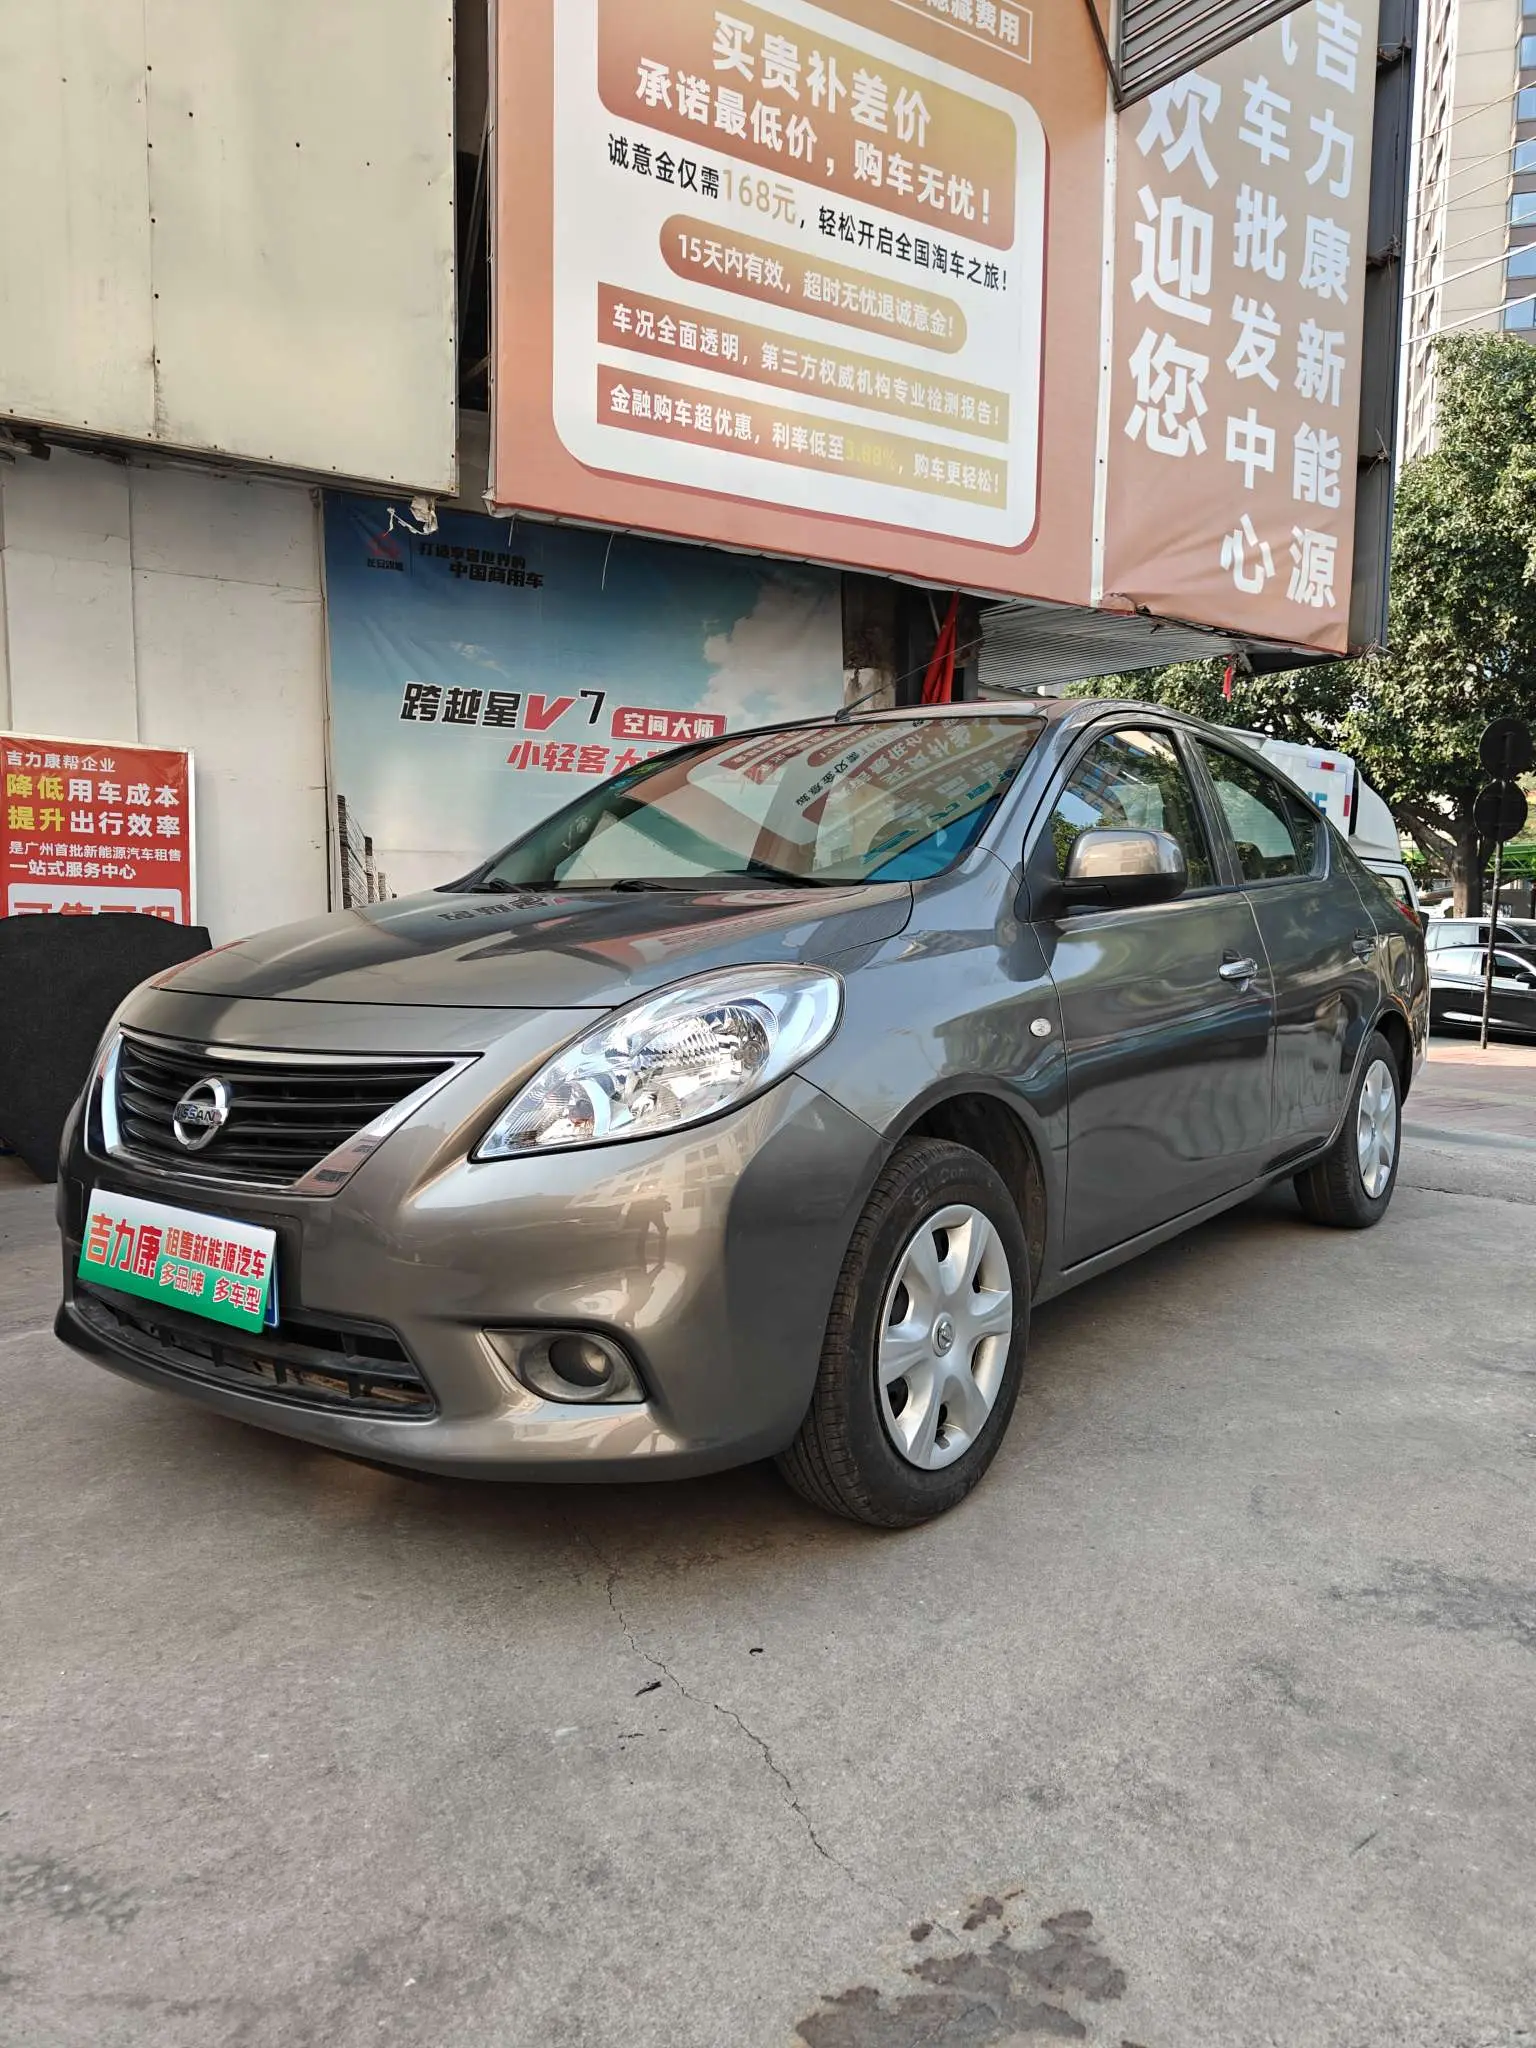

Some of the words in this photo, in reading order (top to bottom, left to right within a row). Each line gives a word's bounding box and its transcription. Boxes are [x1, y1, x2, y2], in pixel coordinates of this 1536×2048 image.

[712, 12, 932, 150] 买贵补差价
[635, 57, 993, 224] 承诺最低价，购车无忧！
[1123, 70, 1222, 458] 欢迎您
[1219, 15, 1300, 595] 车批发中心
[623, 712, 715, 738] 空间大师
[507, 740, 666, 776] 小轻客大
[6, 773, 179, 808] 降低用车成本
[8, 805, 181, 838] 提升出行效率
[9, 841, 182, 863] 是广州首批新能源汽车租售
[9, 859, 137, 880] 一站式服务中心
[86, 1213, 163, 1279] 吉力康
[164, 1226, 268, 1281] 租售新能源汽车
[159, 1262, 205, 1297] 多品牌
[213, 1278, 262, 1314] 多车型
